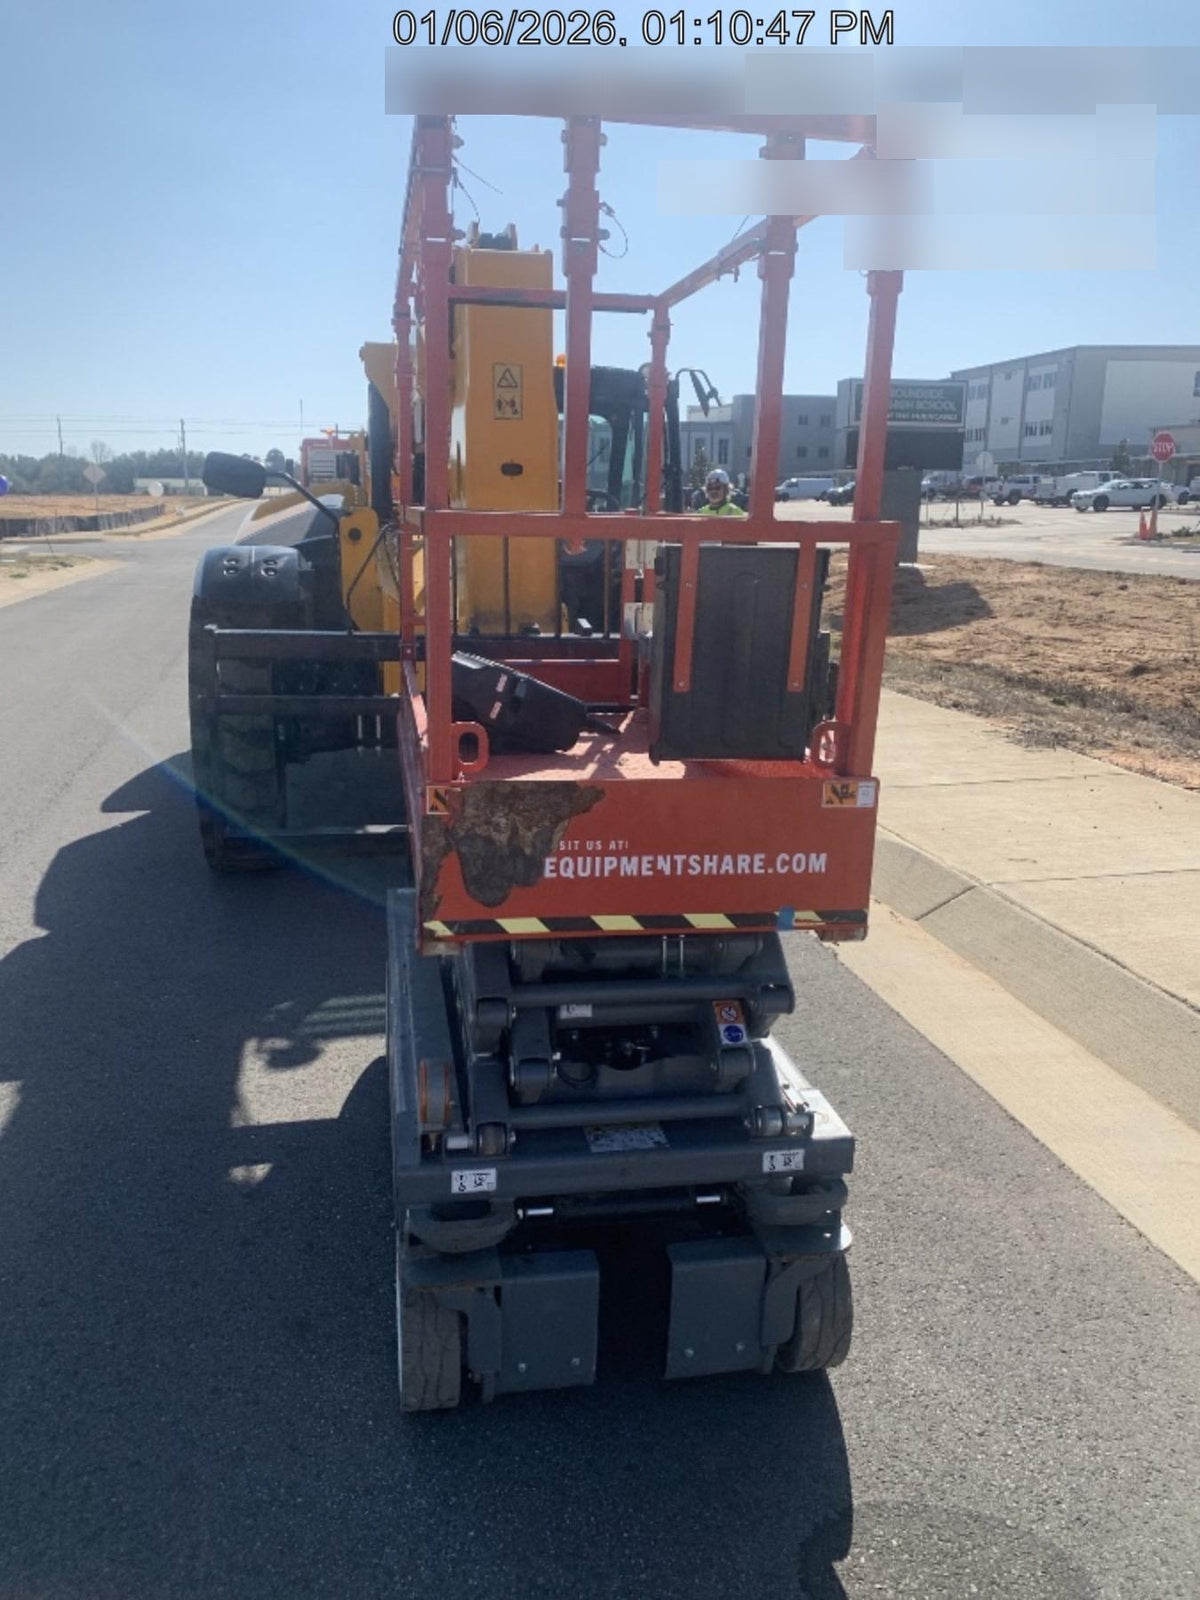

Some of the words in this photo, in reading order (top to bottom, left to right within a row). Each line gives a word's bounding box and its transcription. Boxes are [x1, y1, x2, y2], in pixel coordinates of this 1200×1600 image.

[1153, 442, 1174, 453] STOP
[586, 840, 602, 850] US
[544, 852, 827, 878] EQUIPMENTSHARE.COM
